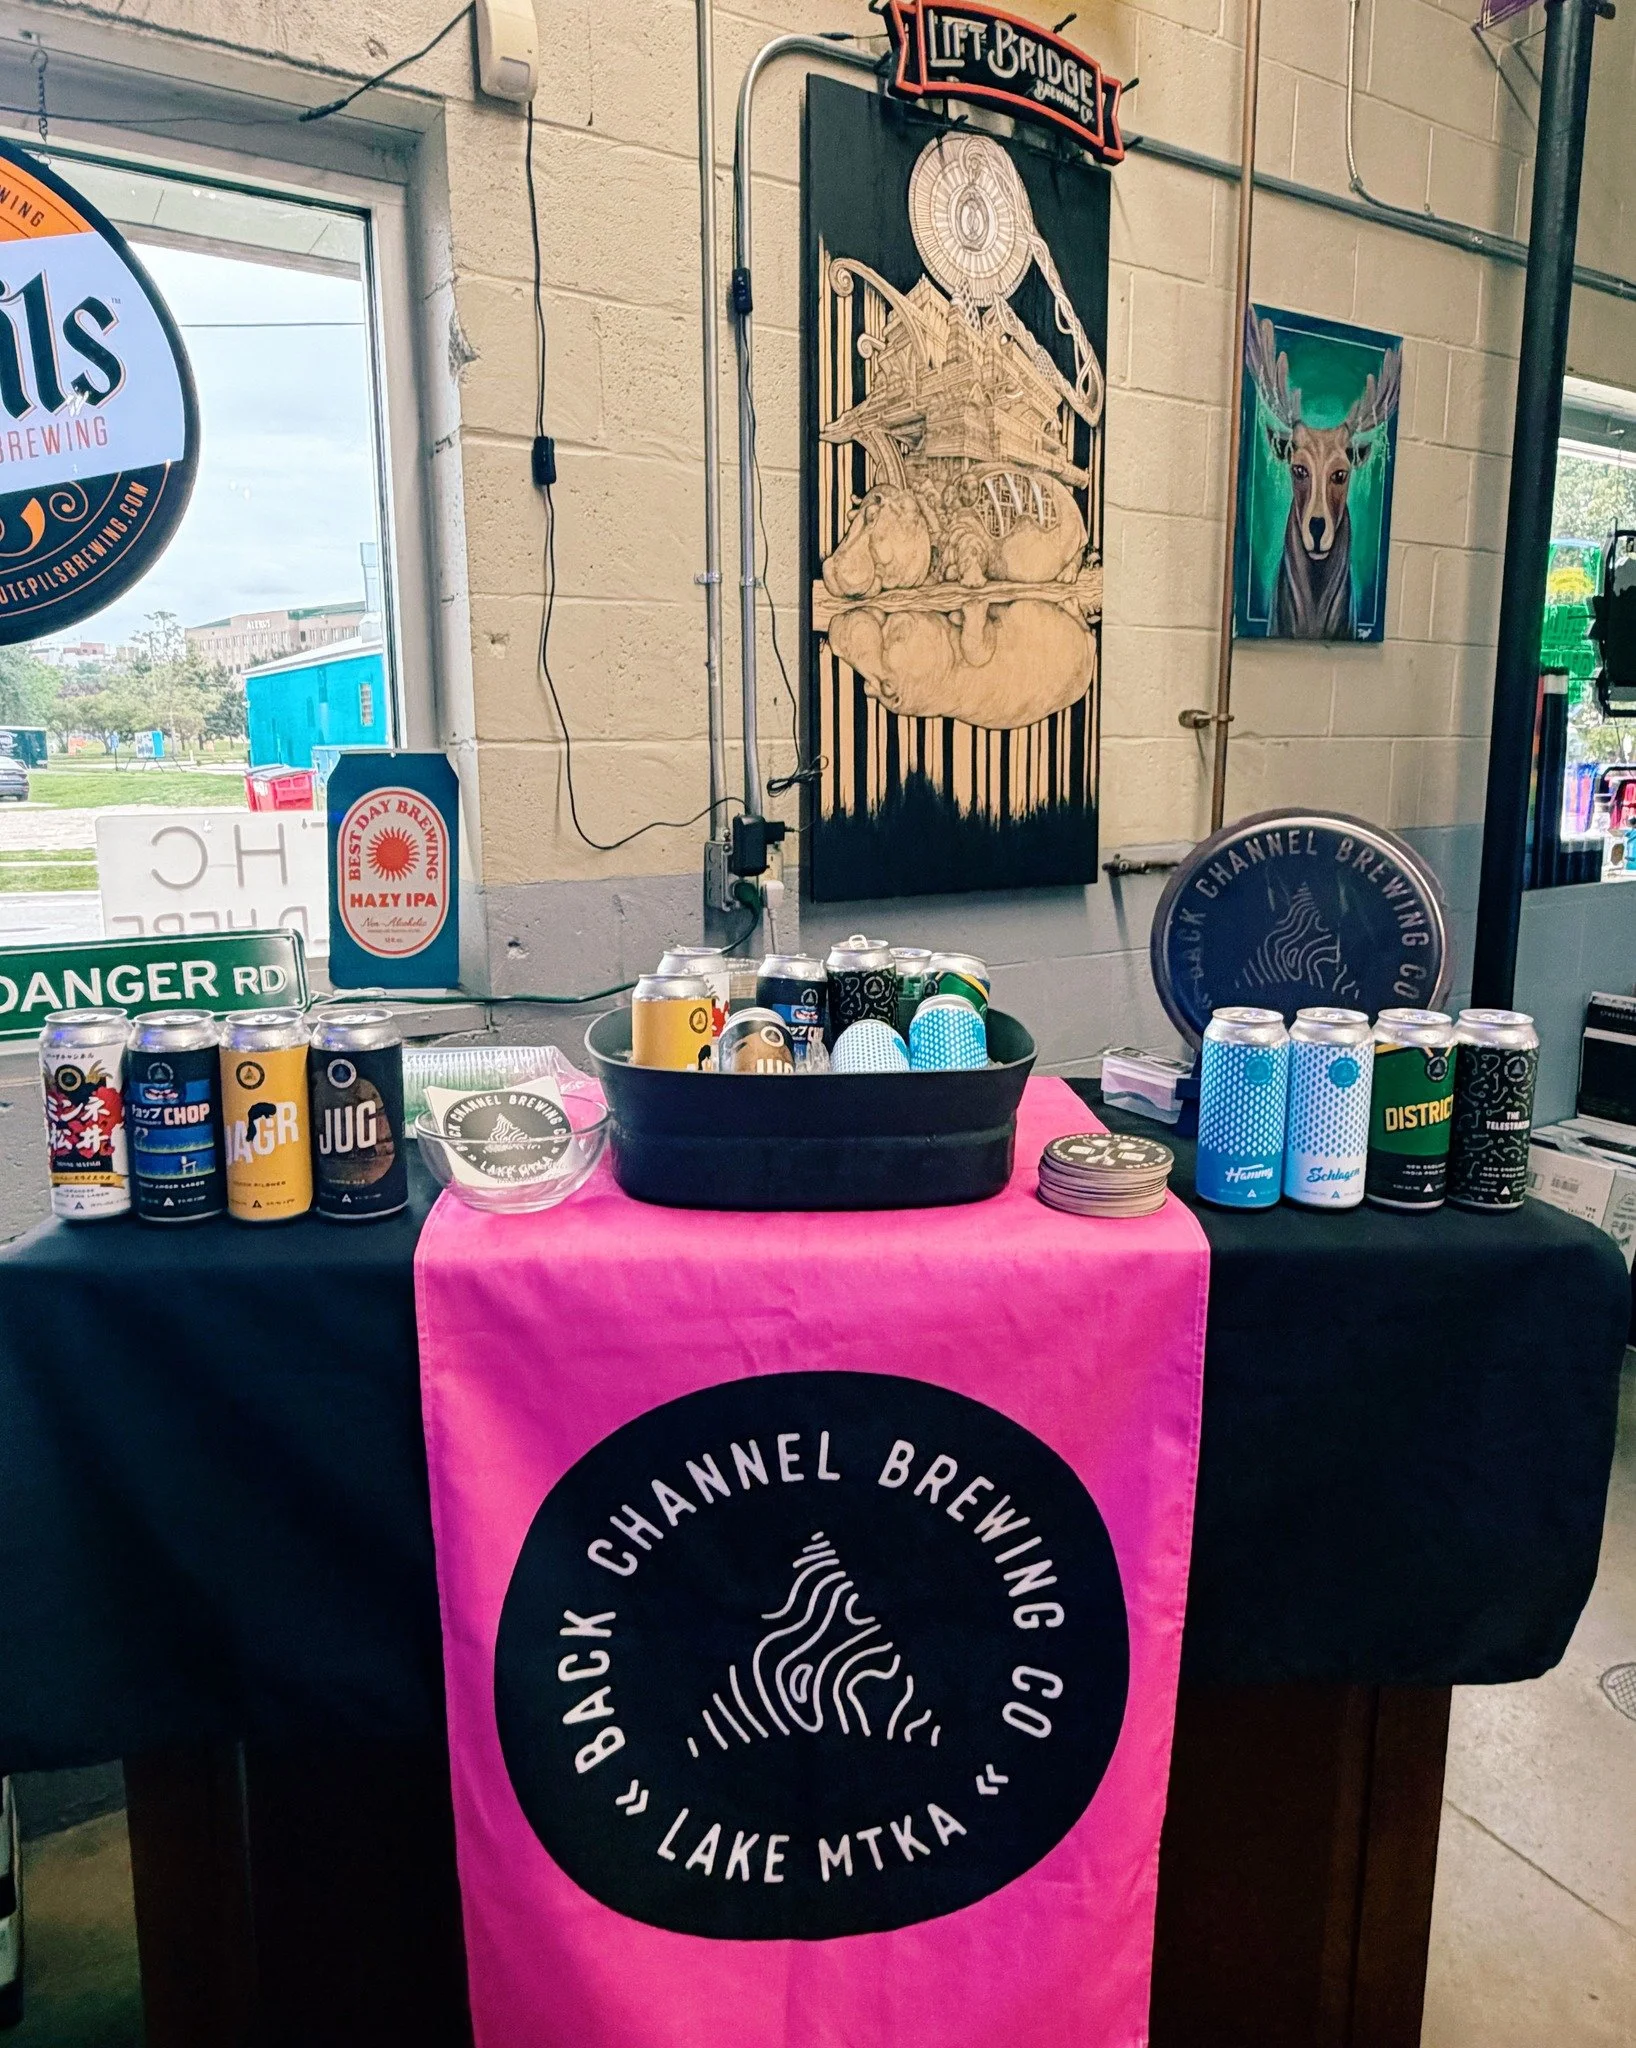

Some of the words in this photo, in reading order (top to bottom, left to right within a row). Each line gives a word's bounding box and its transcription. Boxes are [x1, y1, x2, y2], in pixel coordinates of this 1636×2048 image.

[928, 9, 988, 68] LIFT
[987, 19, 1095, 107] BRIDGE
[0, 415, 108, 464] REWING
[348, 829, 362, 881] BEST
[355, 799, 391, 831] DAY
[396, 799, 439, 881] BREWING
[350, 893, 401, 908] HAZY
[406, 893, 438, 907] IPA
[1195, 829, 1318, 899] CHANNEL
[1334, 837, 1430, 947] BREWING
[1393, 963, 1428, 1001] CO
[233, 964, 287, 995] RD
[163, 1102, 211, 1126] CHOP
[319, 1100, 377, 1155] JUG
[450, 1094, 502, 1122] CHANNEL
[508, 1094, 563, 1125] BREWING
[587, 1431, 841, 1577] CHANNEL
[878, 1439, 1066, 1629] BREWING
[557, 1609, 627, 1774] BACK
[1001, 1664, 1065, 1739] CO
[656, 1807, 791, 1884] LAKE
[818, 1802, 968, 1882] MTKA
